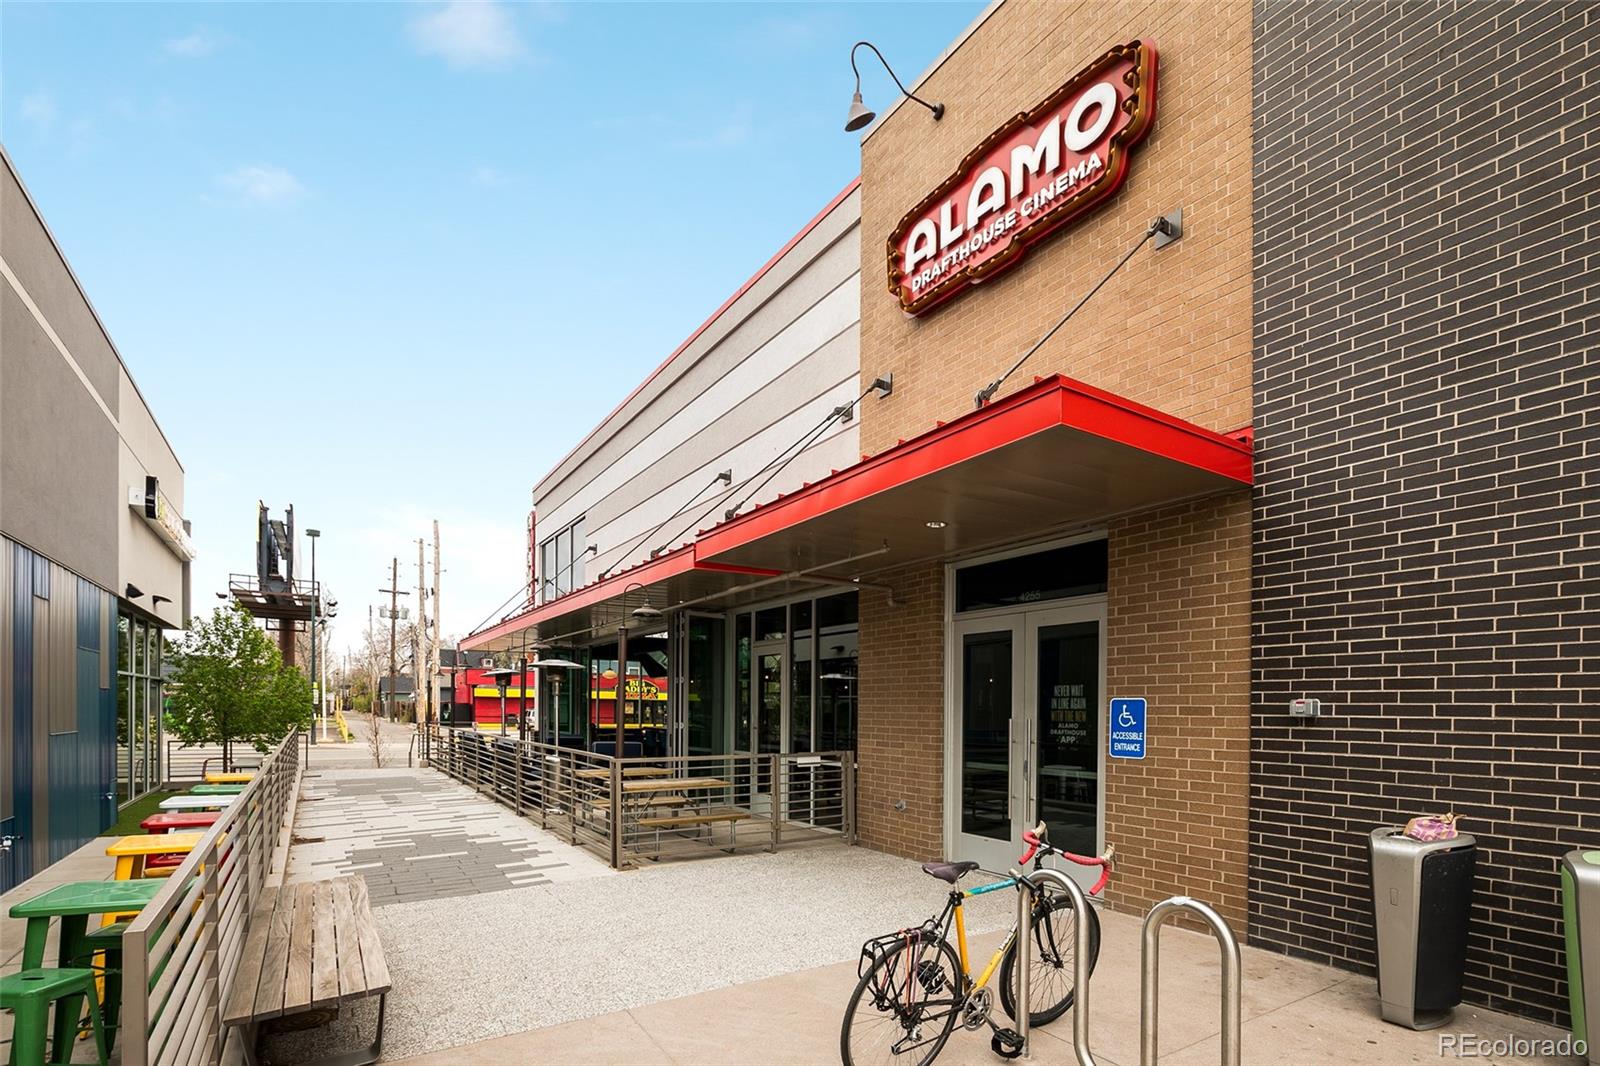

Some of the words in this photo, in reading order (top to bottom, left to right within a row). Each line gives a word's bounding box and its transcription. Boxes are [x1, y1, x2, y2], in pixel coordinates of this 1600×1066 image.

[905, 82, 1117, 274] ALAMO
[911, 211, 1018, 293] DRAFTHOUSE
[1020, 152, 1103, 217] CINEMA
[624, 685, 657, 694] ADDY'S
[1054, 685, 1070, 697] NEVER
[1071, 685, 1084, 697] WAIT
[1060, 736, 1076, 744] APP
[1112, 731, 1143, 741] ACCESSIBLE
[1114, 742, 1141, 751] ENTRANCE
